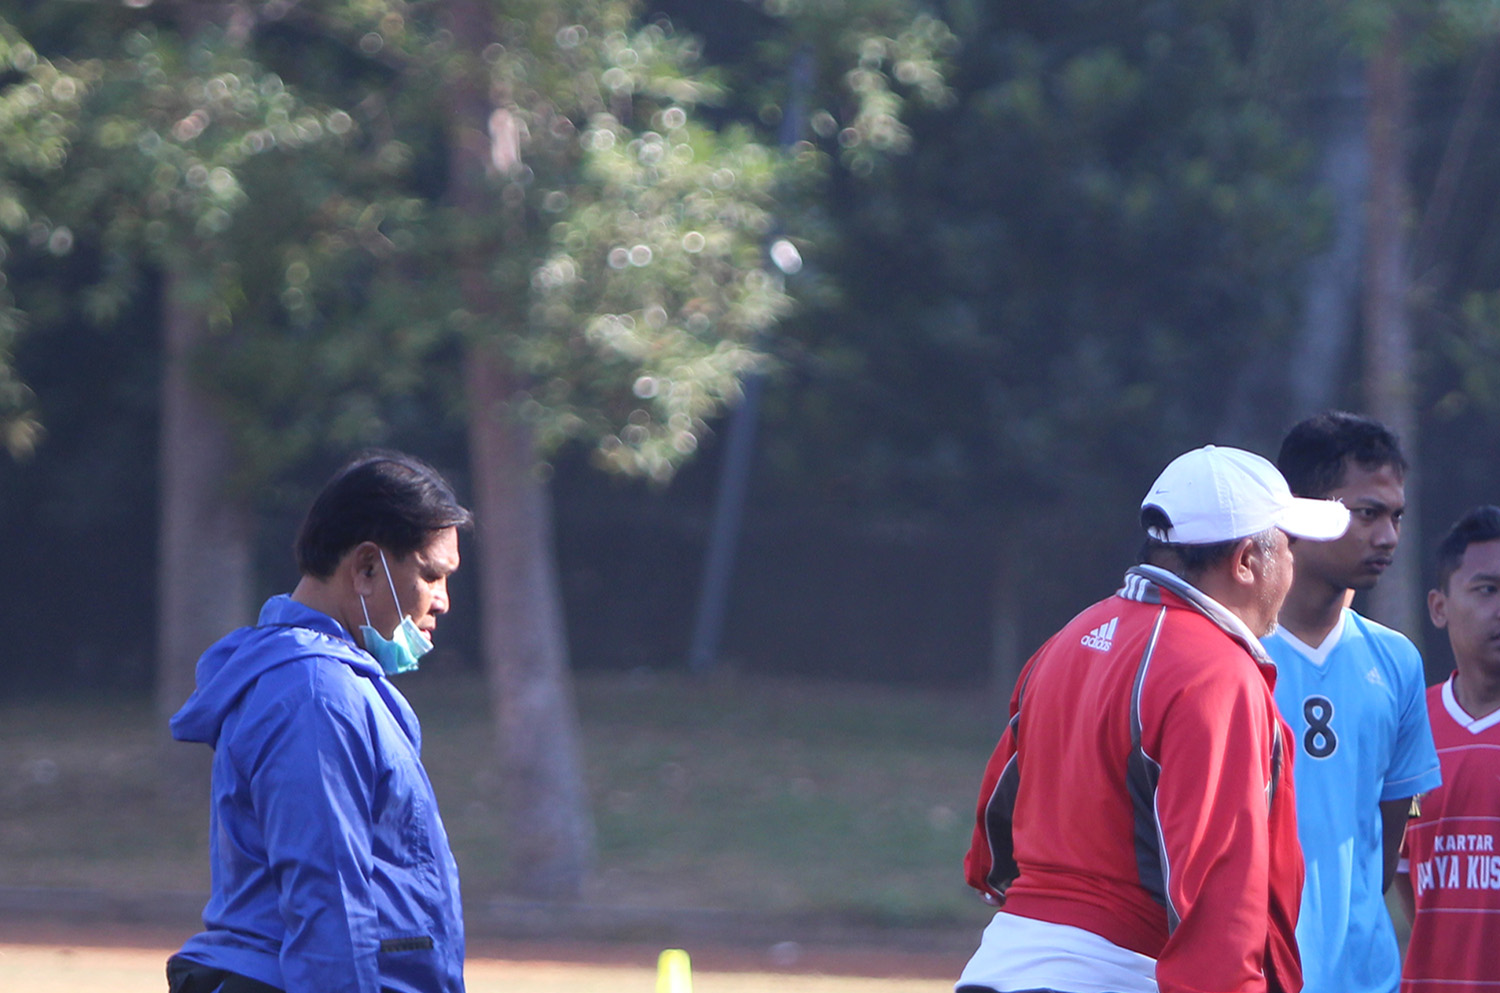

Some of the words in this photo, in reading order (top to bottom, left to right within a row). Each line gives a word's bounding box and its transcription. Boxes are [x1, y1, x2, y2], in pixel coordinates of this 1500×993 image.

[1081, 635, 1112, 651] adidas
[1302, 694, 1338, 760] 8
[1434, 834, 1494, 853] KARTAR
